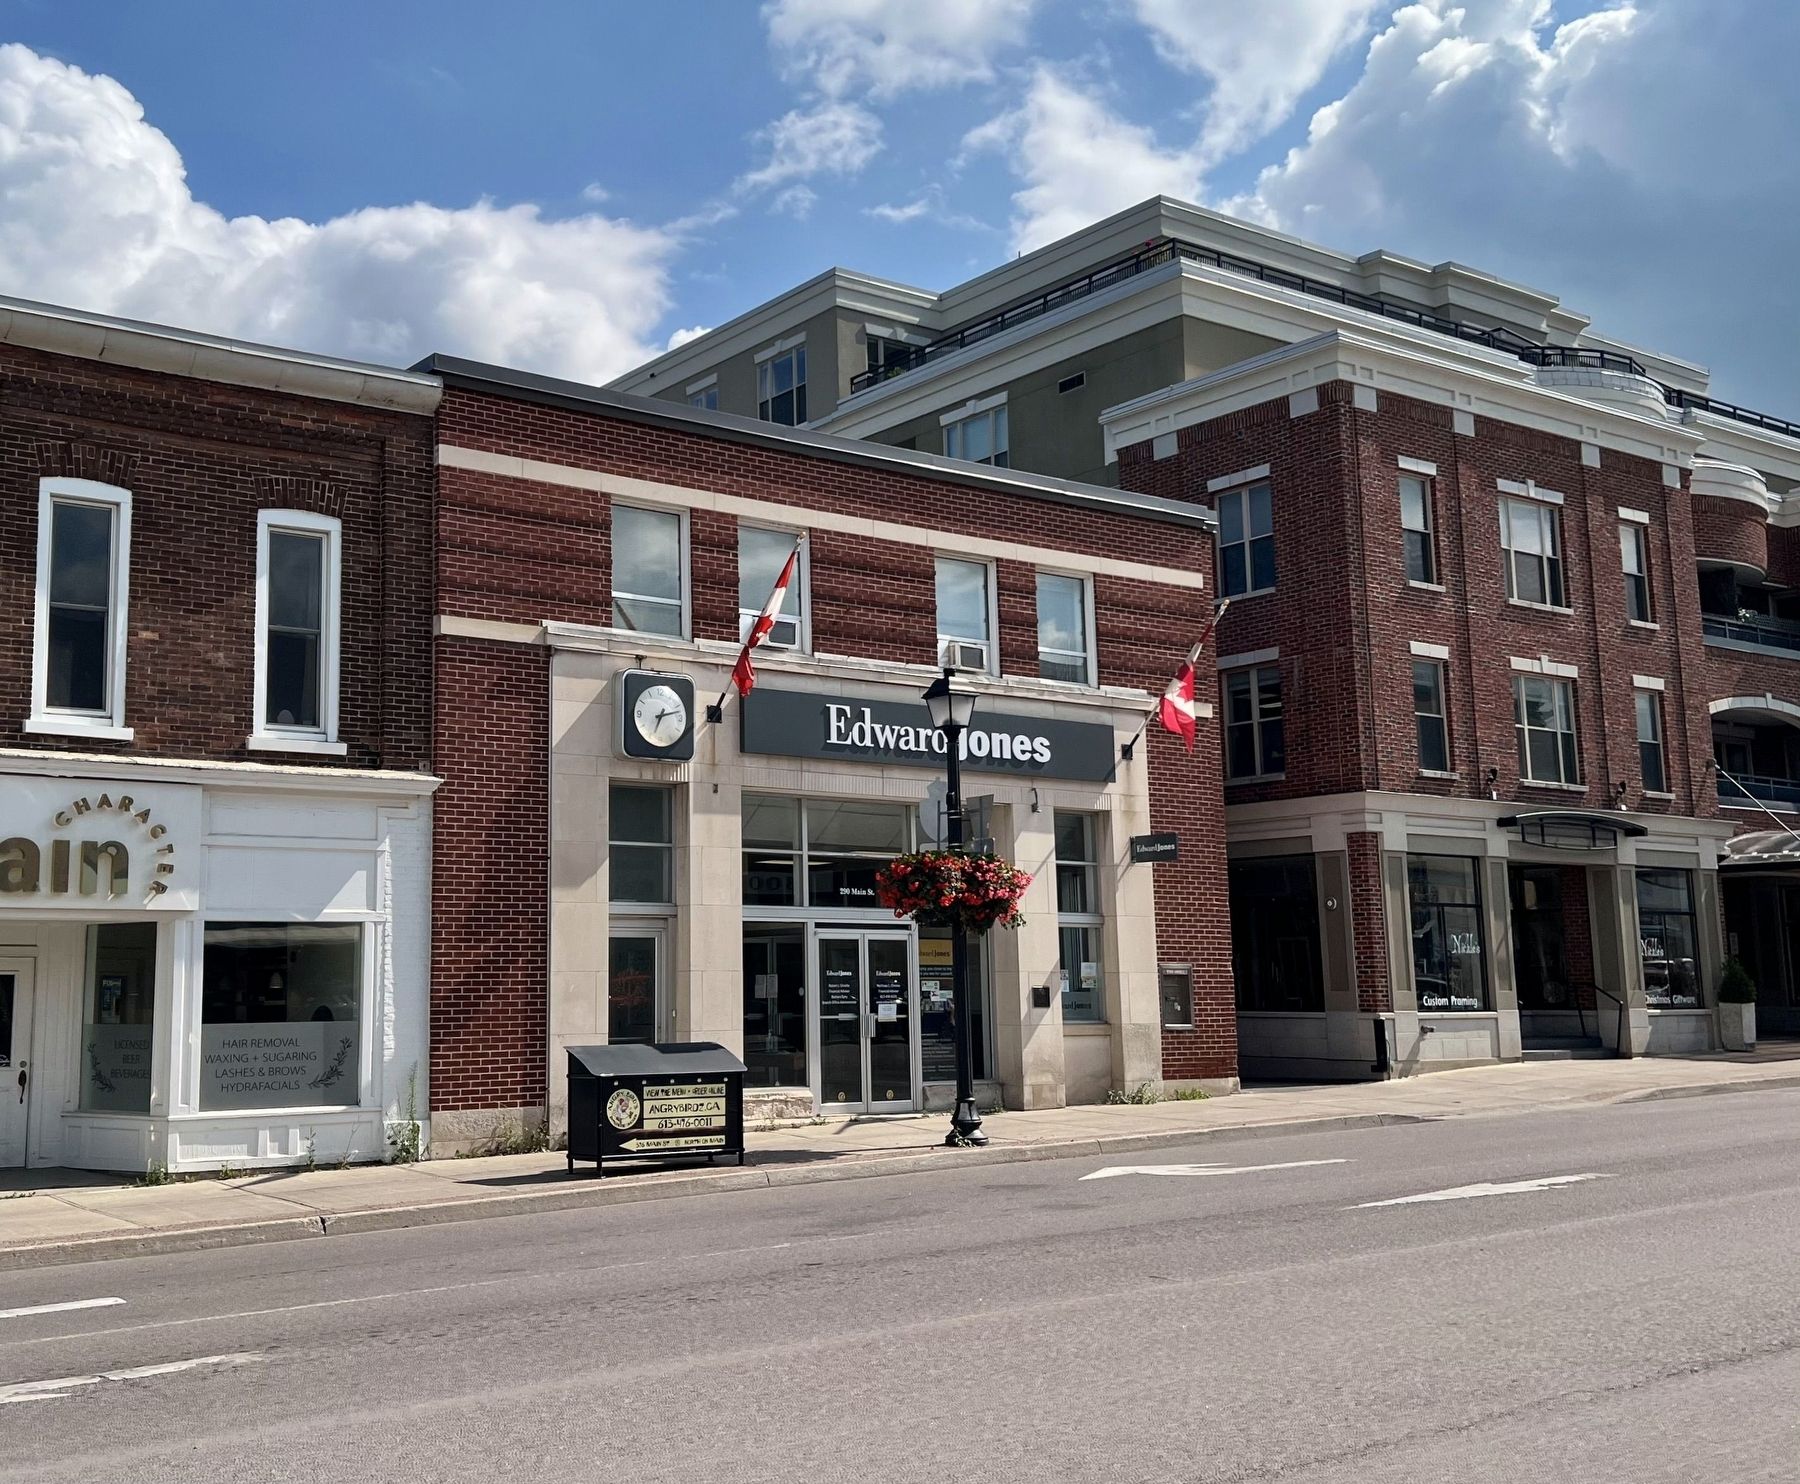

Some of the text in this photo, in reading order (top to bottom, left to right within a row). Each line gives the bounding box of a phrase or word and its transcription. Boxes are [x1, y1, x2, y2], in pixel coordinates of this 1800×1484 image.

[657, 688, 664, 696] 12
[637, 710, 642, 718] 9
[958, 727, 1051, 763] Jones
[55, 793, 174, 895] CHARACTER
[1423, 995, 1448, 1006] Custom
[222, 1038, 300, 1048] HAIR REMOVAL
[204, 1053, 249, 1064] WAXING
[262, 1051, 317, 1062] SUGARING
[215, 1065, 307, 1079] LASHES & BROWS
[221, 1080, 300, 1093] HYDRAFACIALS
[649, 1102, 720, 1114] ANGRYBIRDZ.CA
[657, 1117, 712, 1129] 613-476-0011
